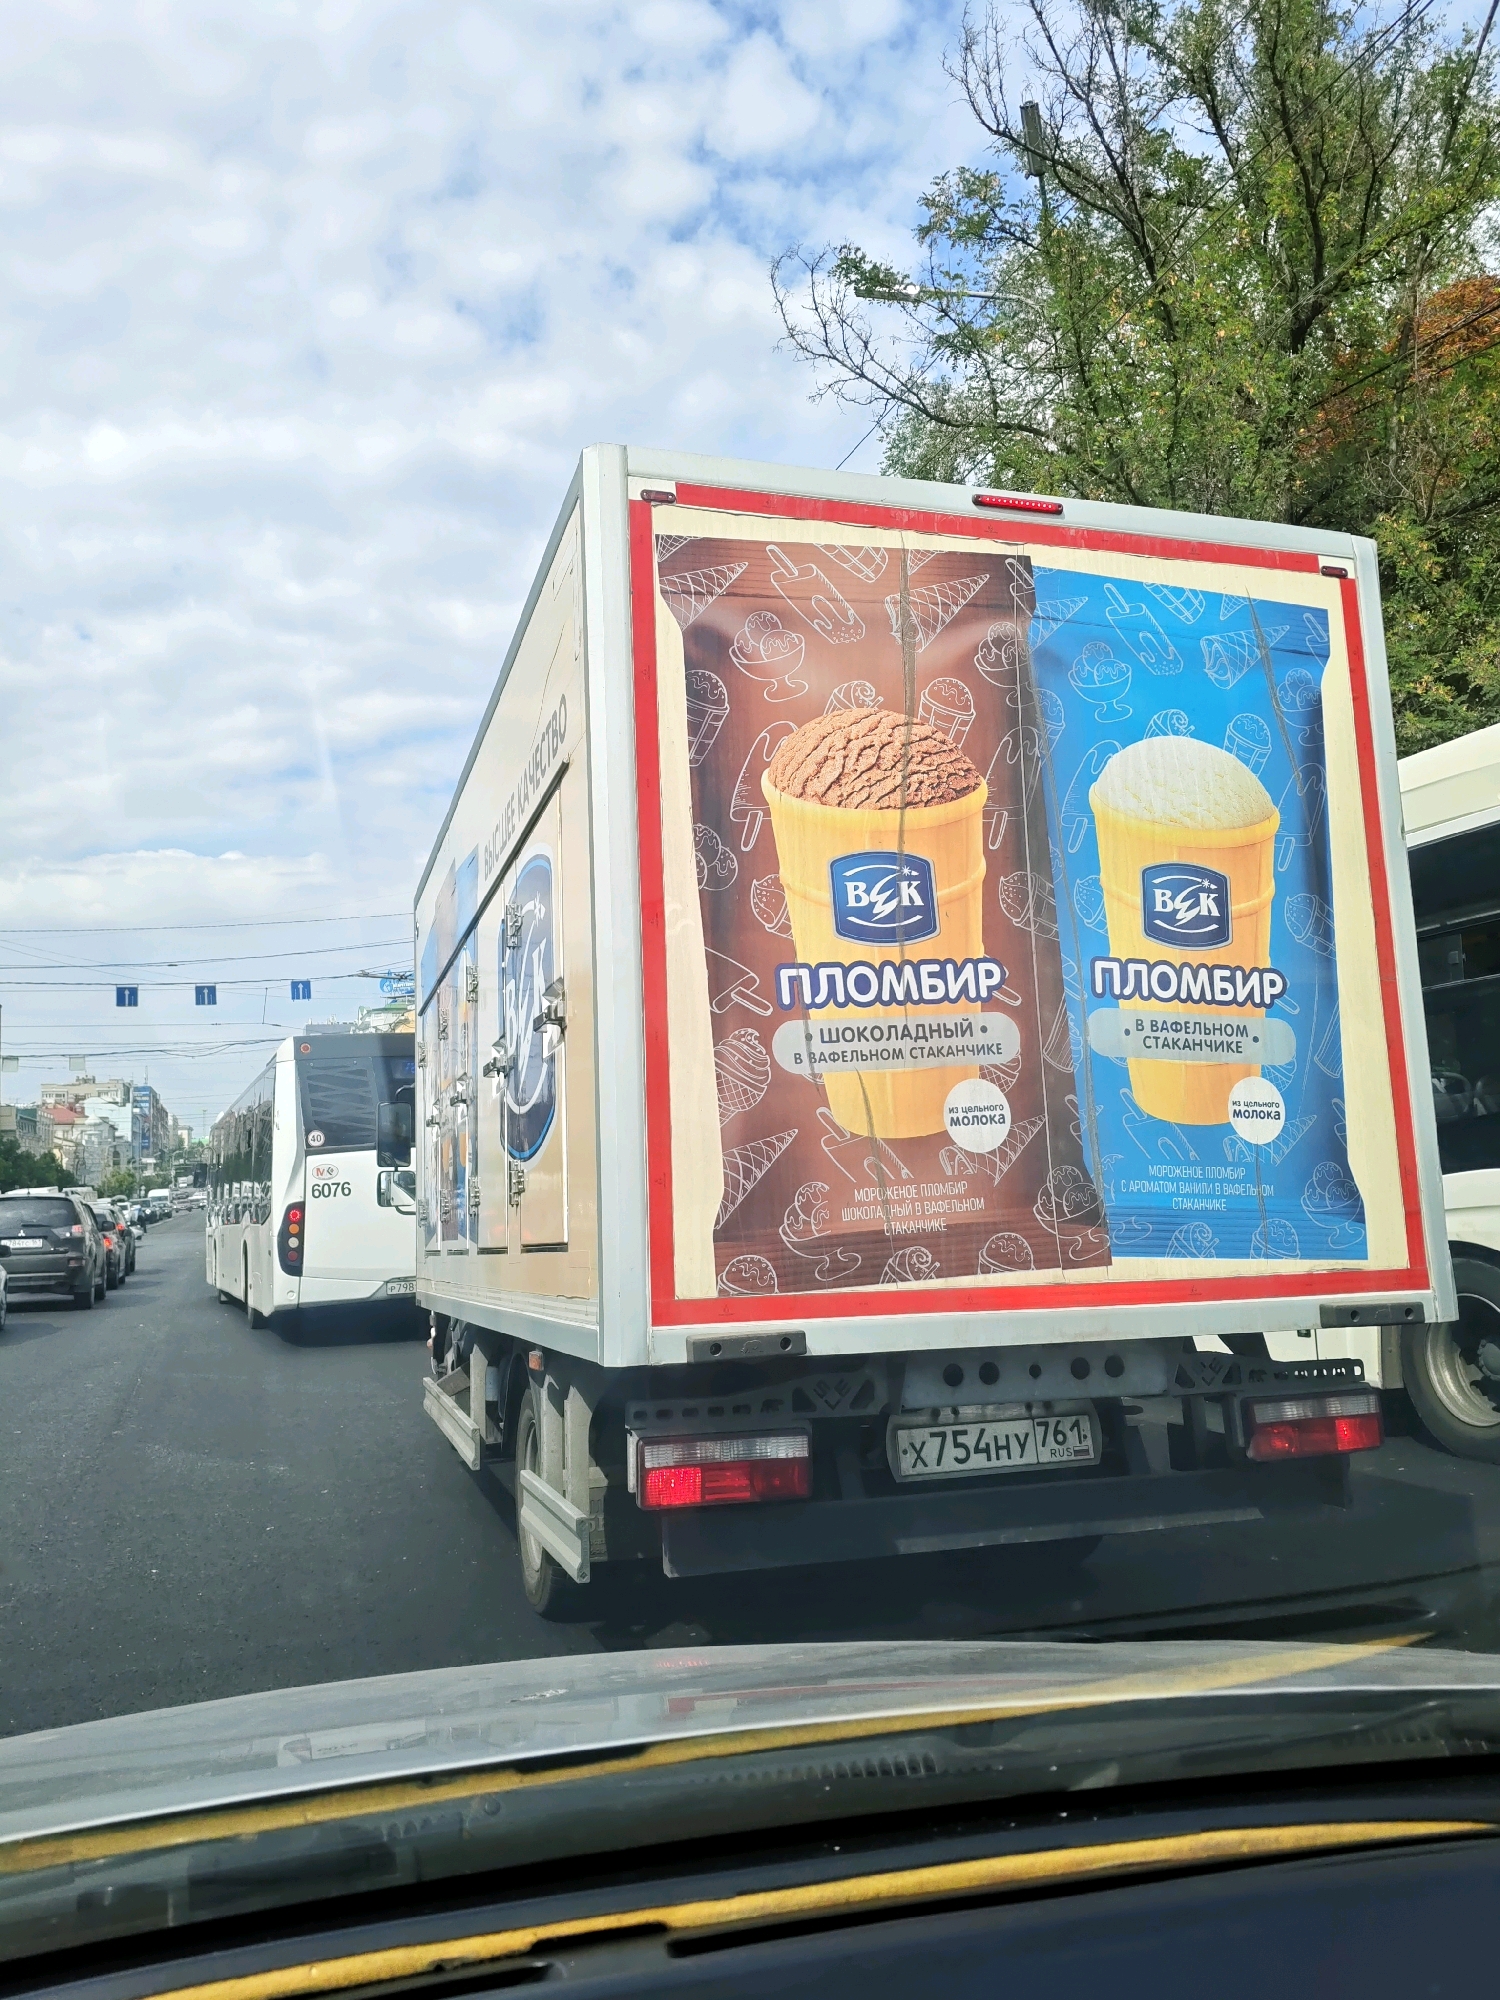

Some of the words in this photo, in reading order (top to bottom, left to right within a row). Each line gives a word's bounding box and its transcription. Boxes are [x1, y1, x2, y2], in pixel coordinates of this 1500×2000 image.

[484, 791, 516, 882] ВЫСШЕЕ
[517, 693, 568, 823] КАЧЕСТВО
[778, 961, 1002, 1006] ПЛОМБИР
[1093, 960, 1284, 1005] ПЛОМБИР
[819, 1018, 974, 1044] ШОКОЛАДНЫЙ
[1135, 1018, 1145, 1032] В
[1150, 1019, 1249, 1038] ВАФЕЛЬНОМ
[794, 1053, 804, 1065] В
[809, 1048, 905, 1064] ВАФЕЛЬНОМ
[910, 1042, 1003, 1060] СТАКАНЧИКЕ
[1142, 1035, 1243, 1054] СТАКАНЧИКЕ
[961, 1103, 1005, 1114] цельного
[1232, 1108, 1281, 1121] молока
[949, 1112, 1006, 1127] молока
[310, 1134, 322, 1143] 40
[1148, 1164, 1203, 1179] МОРОЖЕНОЕ
[1205, 1166, 1246, 1180] ПЛОМБИР
[311, 1181, 352, 1199] 6076
[854, 1184, 918, 1203] МОРОЖЕНОЕ
[920, 1180, 968, 1197] ПЛОМБИР
[1121, 1180, 1127, 1192] С
[1129, 1180, 1177, 1194] АРОМАТОМ
[1179, 1182, 1213, 1195] ВАНИЛИ
[1215, 1183, 1221, 1195] В
[1224, 1183, 1275, 1197] ВАФЕЛЬНОМ
[842, 1200, 914, 1221] ШОКОЛАДНЫЙ
[916, 1203, 922, 1215] В
[924, 1197, 985, 1215] ВАФЕЛЬНОМ
[1172, 1198, 1227, 1212] СТАКАНЧИКЕ
[884, 1217, 948, 1236] СТАКАНЧИКЕ
[390, 1282, 415, 1293] Р798
[909, 1427, 1030, 1469] Х754НУ
[1036, 1419, 1082, 1448] 761
[1050, 1448, 1073, 1459] RUS
